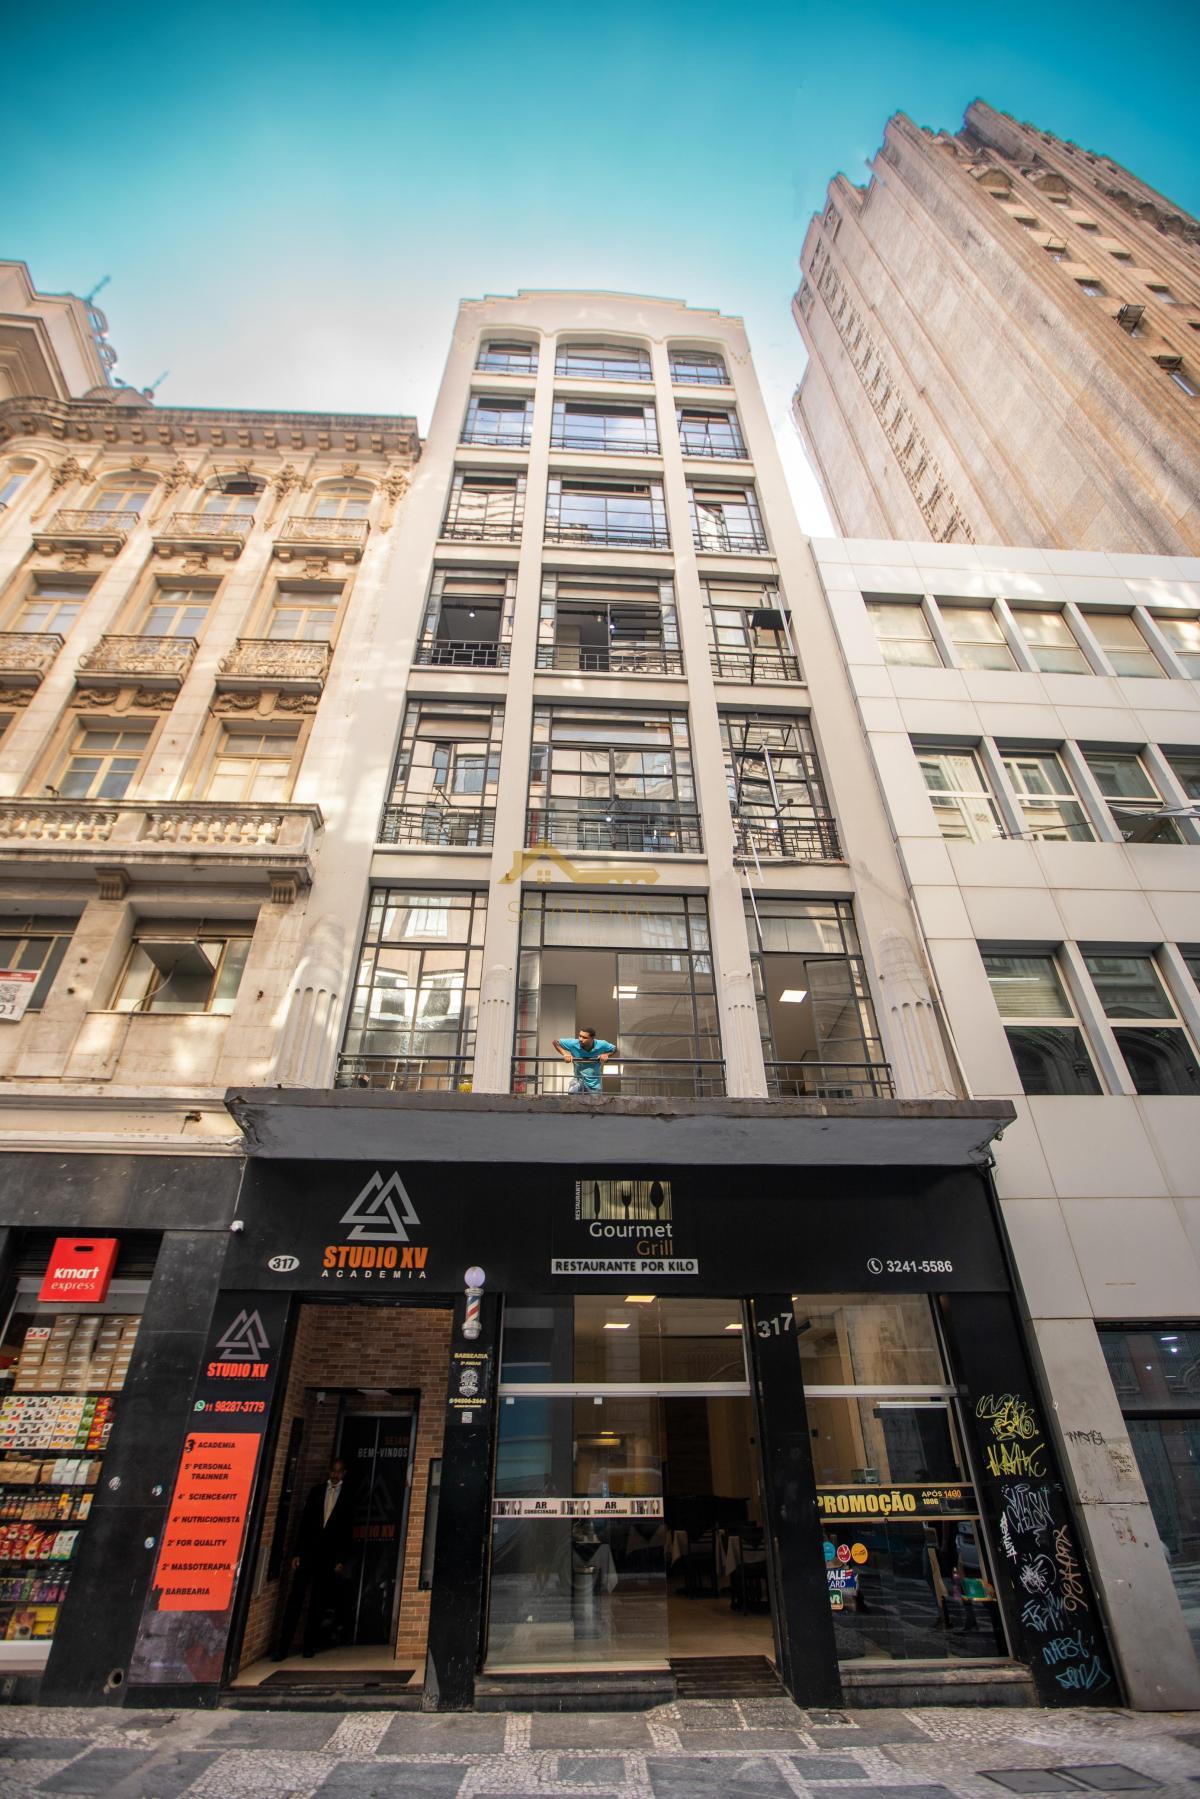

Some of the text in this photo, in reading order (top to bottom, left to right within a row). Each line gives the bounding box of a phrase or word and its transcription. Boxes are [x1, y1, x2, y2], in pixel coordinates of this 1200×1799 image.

[589, 1222, 673, 1238] Gourmet
[636, 1240, 674, 1256] Grill
[272, 1257, 295, 1270] 317
[322, 1246, 429, 1269] STUDIO XV
[53, 1266, 100, 1279] kmart
[555, 1261, 695, 1272] RESTAURANTE POR KILO
[886, 1260, 953, 1273] 3241-5586
[320, 1270, 427, 1279] ACADEMIA
[51, 1281, 95, 1292] express
[757, 1313, 793, 1338] 317
[207, 1362, 269, 1378] STUDIO XV
[214, 1401, 265, 1413] 98287-3779
[921, 1489, 943, 1498] APÓS
[535, 1501, 548, 1509] AR
[604, 1501, 617, 1509] AR
[817, 1491, 917, 1516] PROMOÇÃO
[171, 1563, 231, 1571] MASSOTERAPIA
[828, 1580, 846, 1589] ARD
